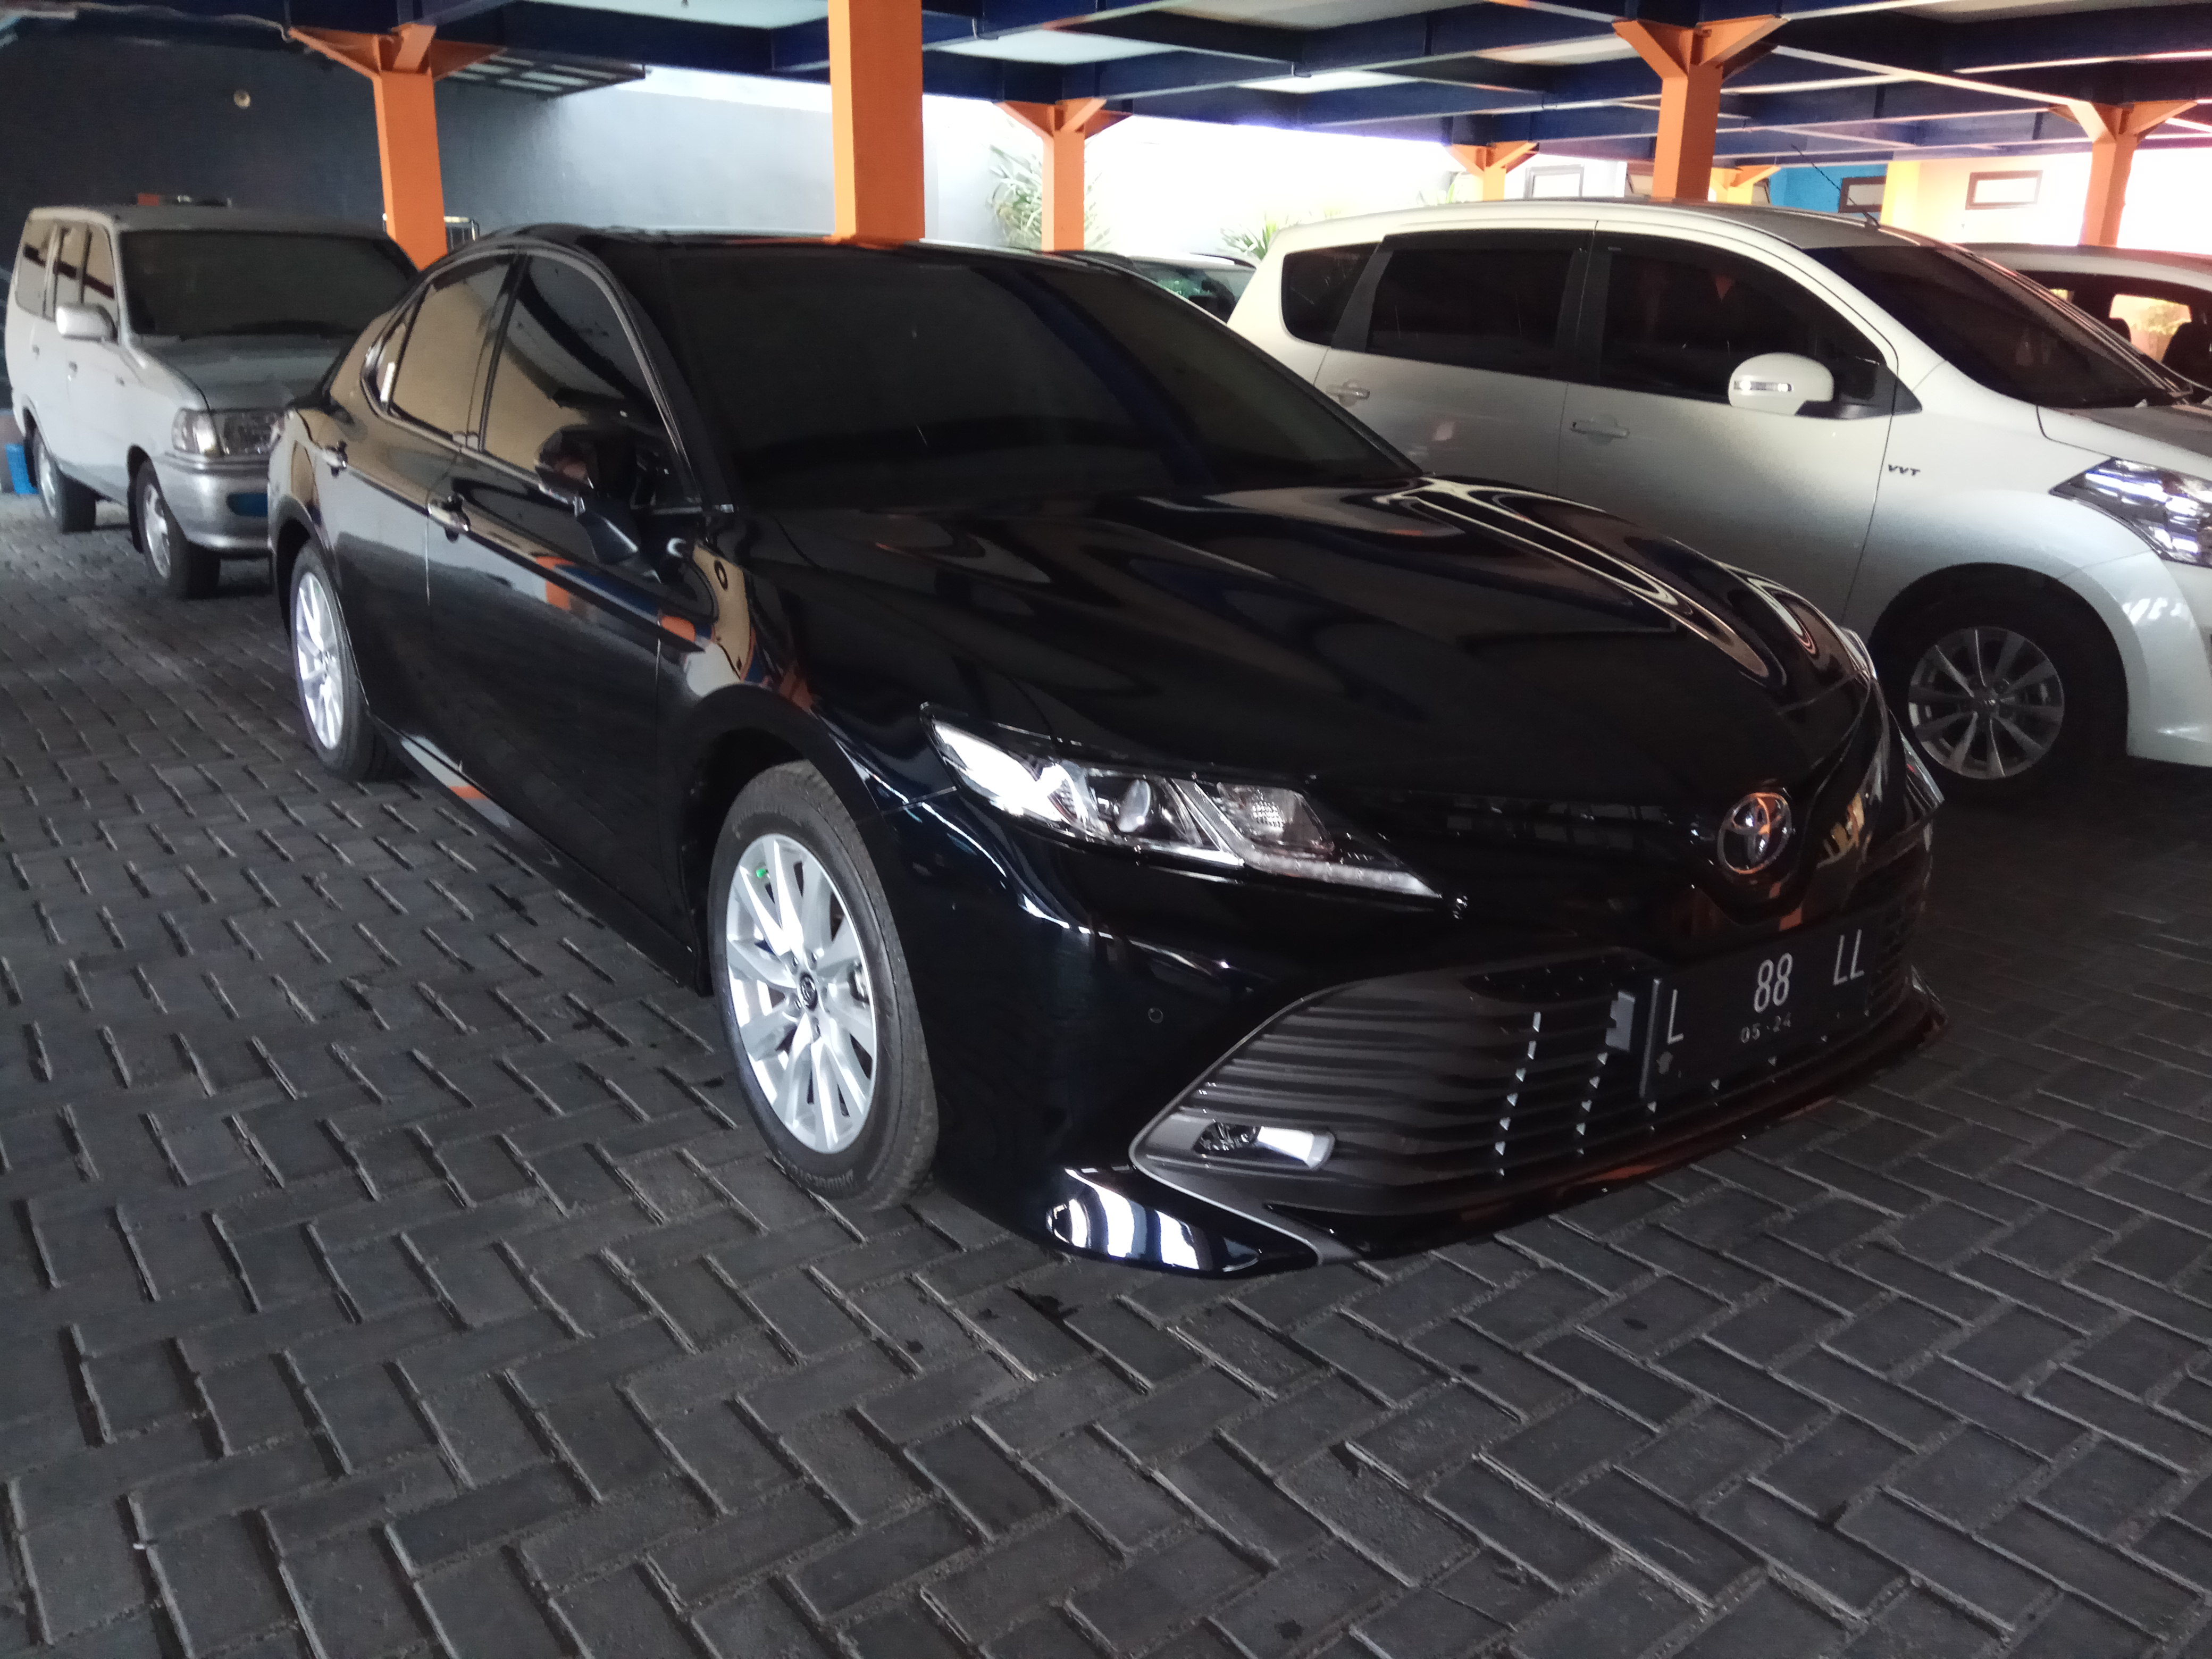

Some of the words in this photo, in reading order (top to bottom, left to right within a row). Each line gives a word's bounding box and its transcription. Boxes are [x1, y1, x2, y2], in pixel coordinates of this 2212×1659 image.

[1888, 464, 1921, 476] VVT
[1666, 989, 1683, 1044] L
[1754, 953, 1792, 1013] 88
[1833, 929, 1864, 985] LL
